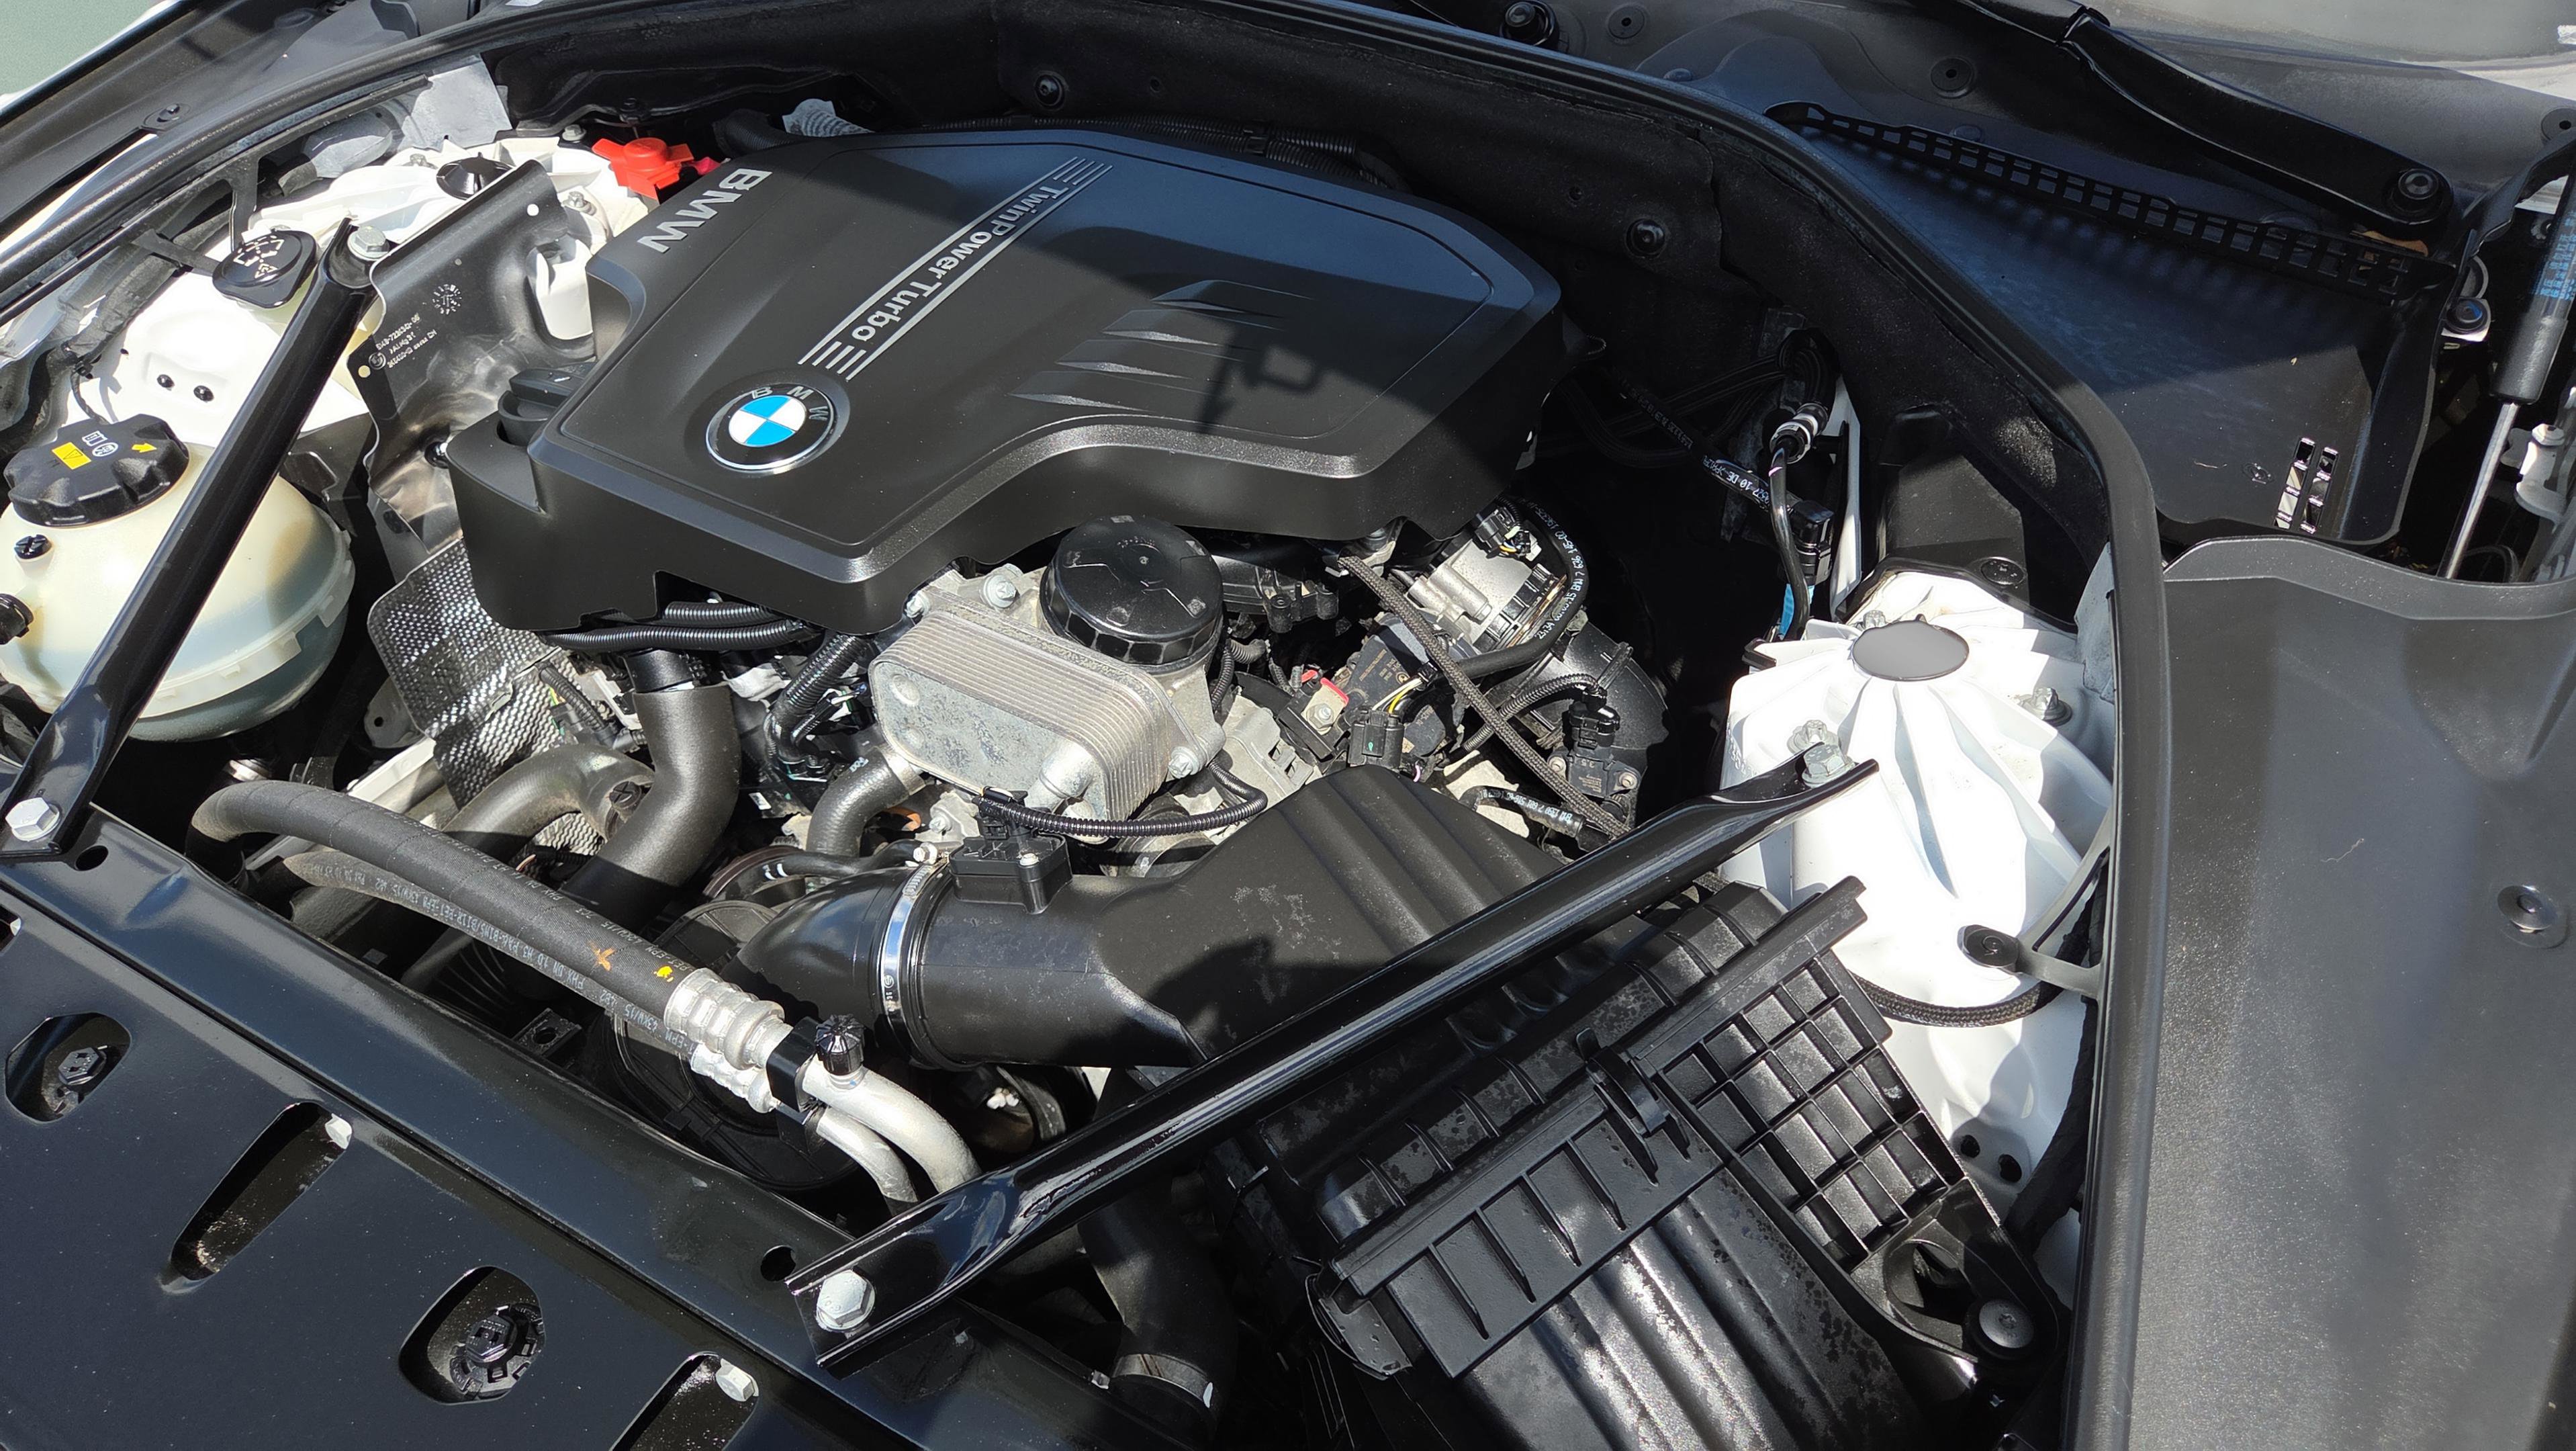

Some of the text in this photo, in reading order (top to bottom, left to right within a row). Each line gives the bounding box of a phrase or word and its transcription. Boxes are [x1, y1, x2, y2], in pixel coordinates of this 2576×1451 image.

[637, 168, 773, 253] BMW
[751, 386, 829, 421] BMW
[1725, 470, 1739, 484] DE
[1571, 555, 1583, 568] 636
[1570, 578, 1583, 591] BMW
[1537, 805, 1544, 813] 7
[565, 969, 586, 989] PHX
